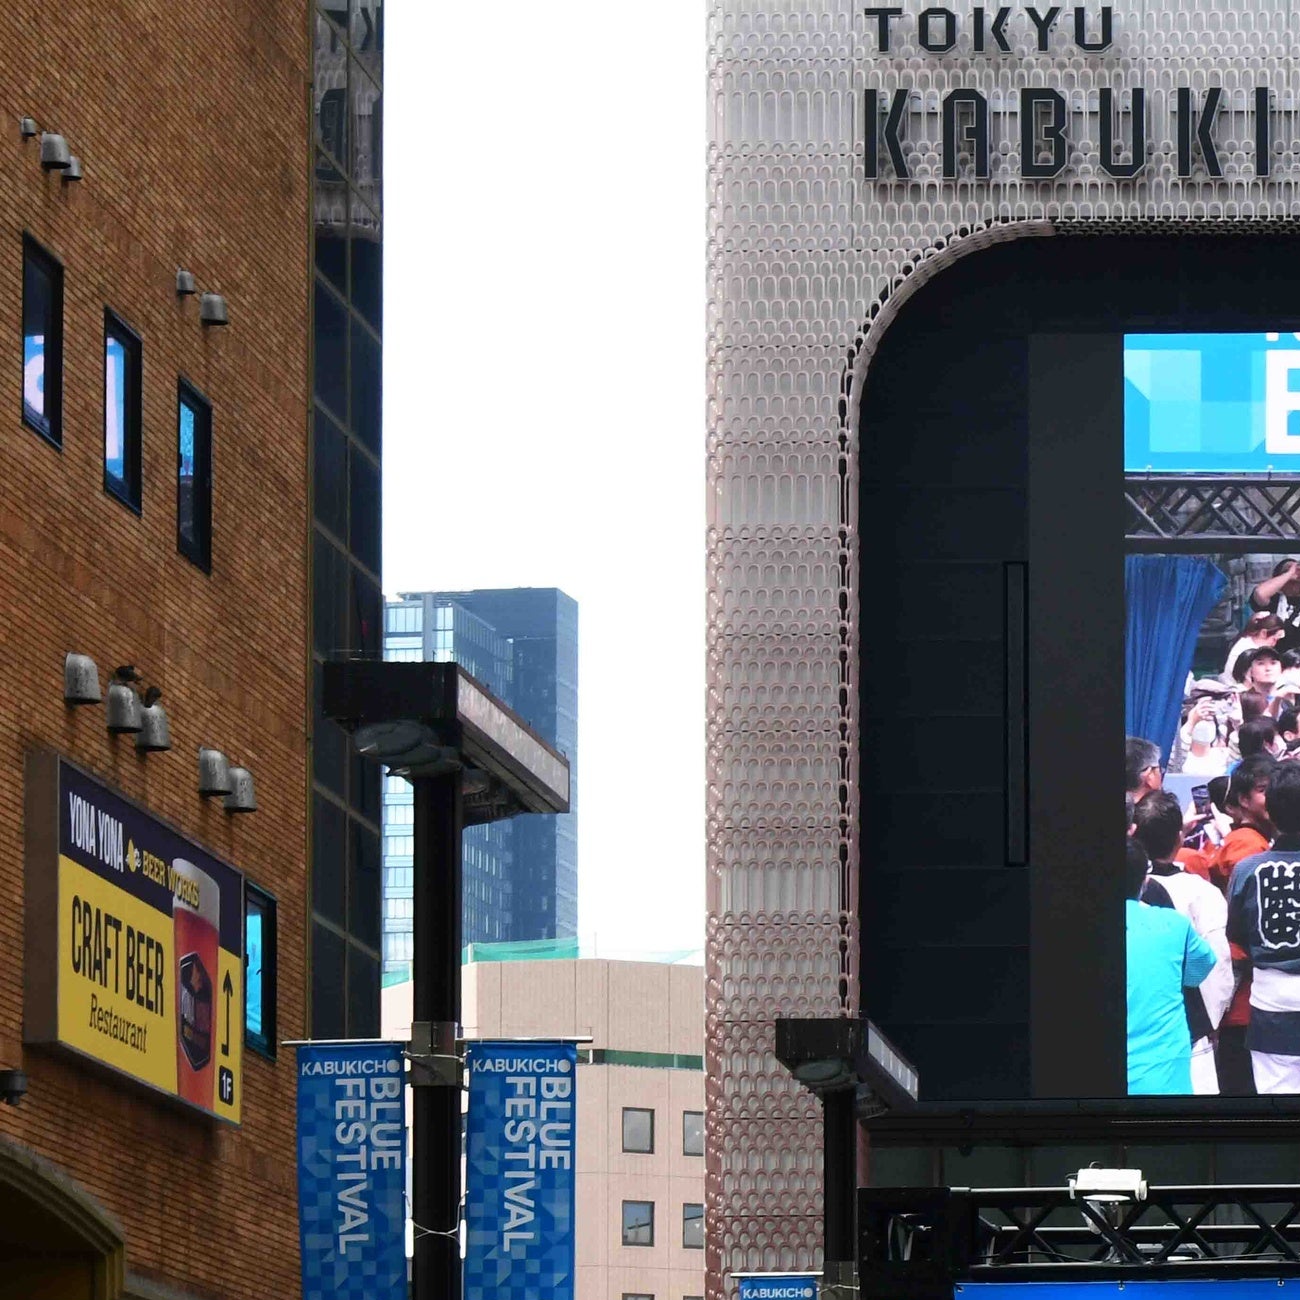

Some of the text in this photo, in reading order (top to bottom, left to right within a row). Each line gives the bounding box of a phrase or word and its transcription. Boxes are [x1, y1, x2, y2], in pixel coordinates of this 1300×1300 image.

[864, 7, 1114, 53] TOKYU
[69, 791, 200, 910] YONA YONA BEER WORKS
[72, 895, 164, 1018] CRAFT BEER
[89, 993, 148, 1054] Restaurant
[222, 1071, 232, 1100] 1F
[301, 1059, 400, 1076] KABUKICHO
[472, 1058, 571, 1073] KABUKICHO
[370, 1077, 401, 1170] BLUE
[539, 1076, 571, 1169] BLUE
[335, 1078, 370, 1255] FESTIVAL
[503, 1076, 537, 1252] FESTIVAL
[743, 1287, 813, 1299] KABUKICHO
